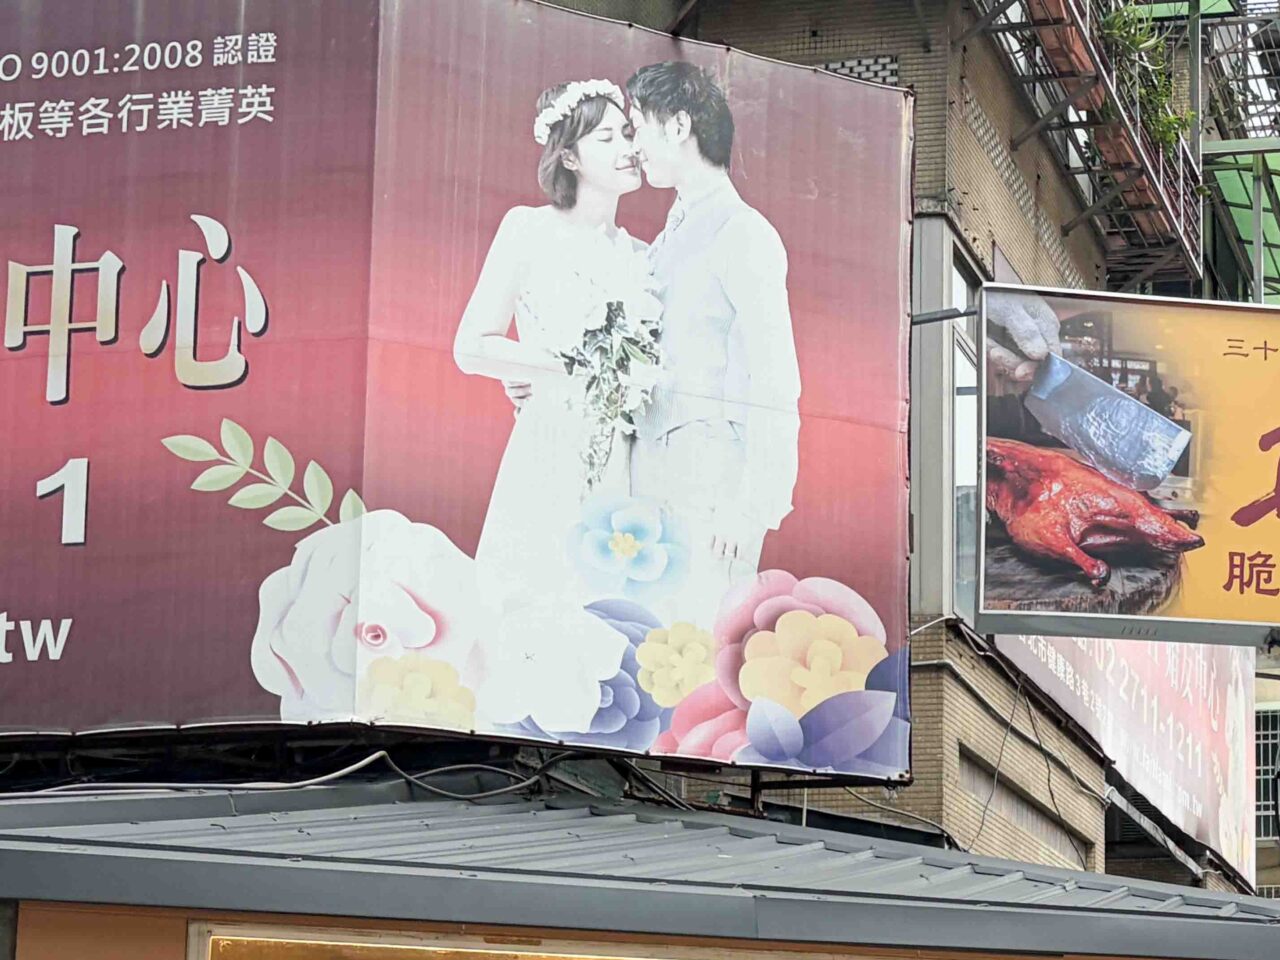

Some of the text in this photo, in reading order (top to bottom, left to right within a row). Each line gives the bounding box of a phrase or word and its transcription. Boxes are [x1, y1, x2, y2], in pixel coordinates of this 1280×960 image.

[31, 40, 203, 79] 9001:2008
[213, 32, 277, 67] 認證
[0, 84, 275, 141] 板等各行業菁英
[4, 214, 268, 404] 中心
[36, 458, 90, 546] 1
